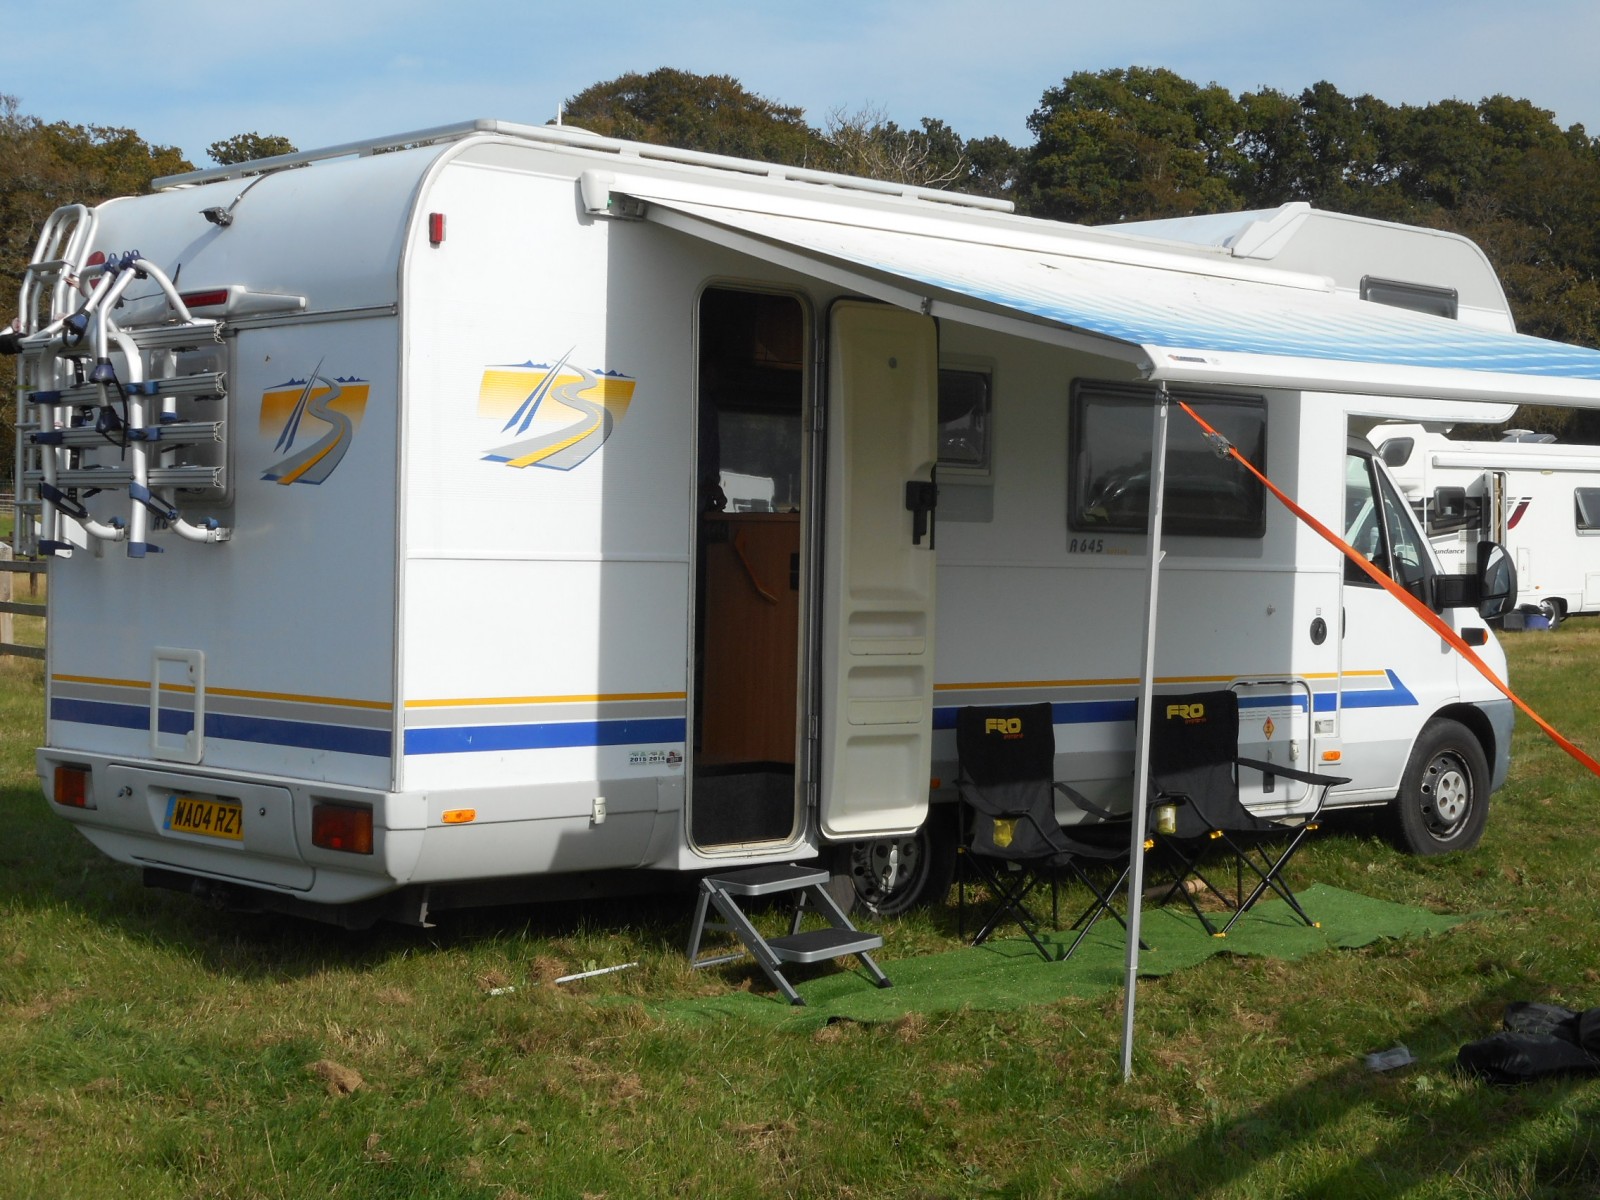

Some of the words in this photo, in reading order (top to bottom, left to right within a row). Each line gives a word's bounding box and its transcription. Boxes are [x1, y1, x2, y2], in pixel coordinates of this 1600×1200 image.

[1080, 539, 1104, 553] 645
[1167, 703, 1204, 719] FRO
[985, 718, 1021, 734] FRO
[174, 801, 213, 830] WA04
